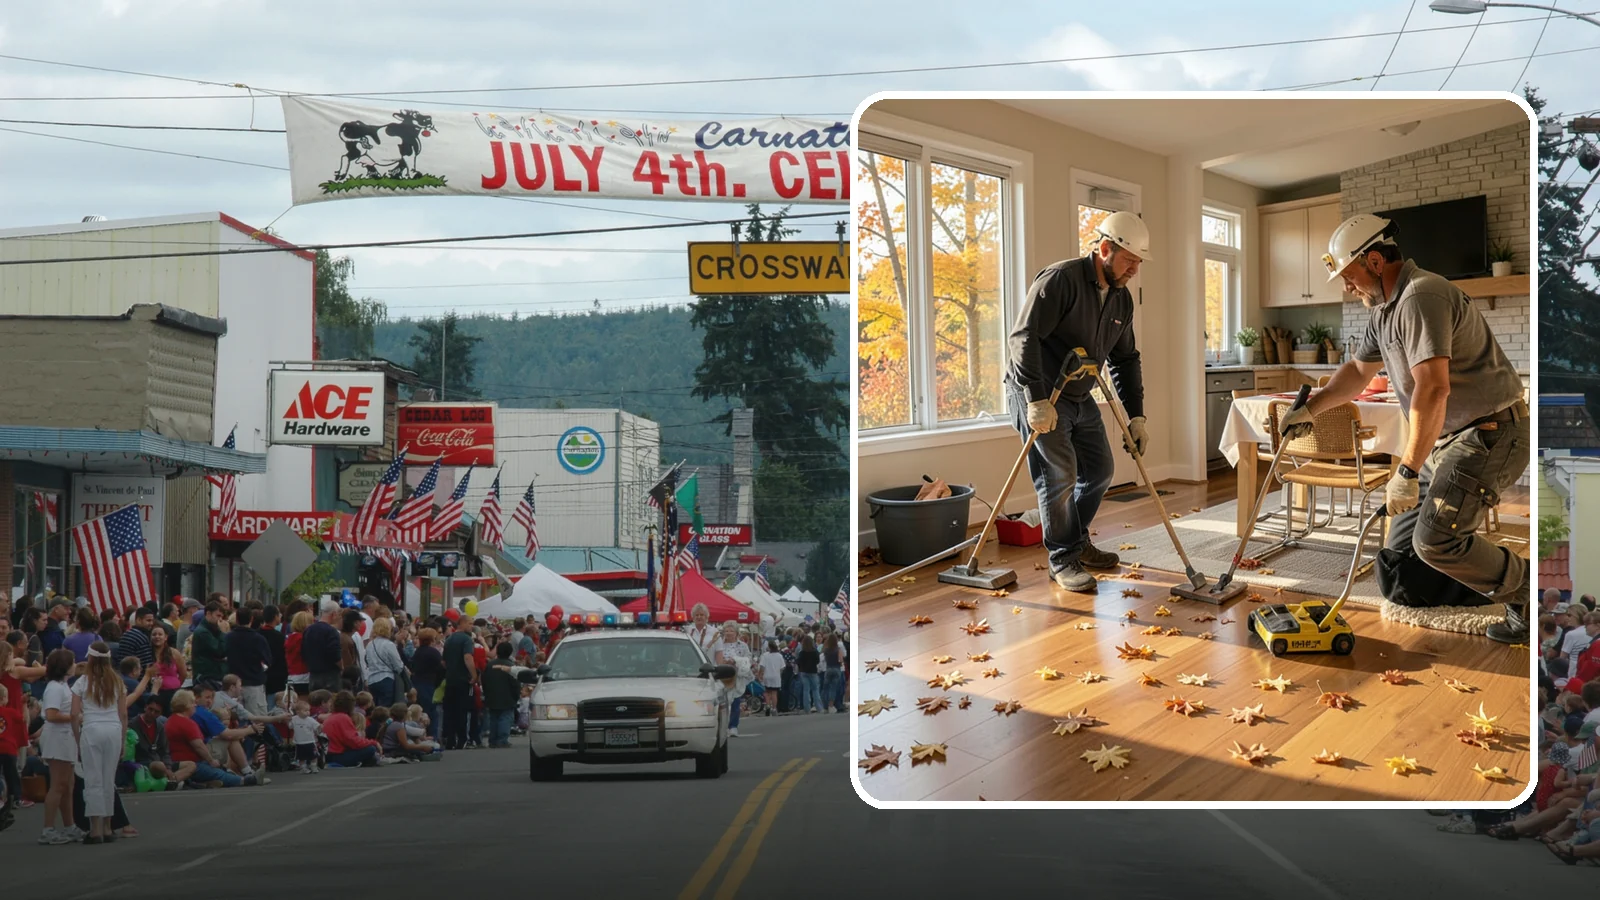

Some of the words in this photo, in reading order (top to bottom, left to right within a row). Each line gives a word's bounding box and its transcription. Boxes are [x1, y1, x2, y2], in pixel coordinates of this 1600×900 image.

[695, 121, 850, 149] Carnat
[481, 141, 604, 192] JULY
[632, 150, 746, 198] 4th.
[697, 254, 850, 280] CROSSWA
[283, 380, 373, 420] ACE
[405, 409, 453, 422] CEDAR
[461, 409, 485, 421] LOG
[283, 421, 371, 436] Hardware
[416, 428, 477, 446] Coca-Cola
[353, 467, 384, 480] Simpl
[95, 484, 124, 494] Vincent
[126, 486, 136, 494] de
[138, 486, 155, 495] Paul
[688, 526, 741, 535] CRNATION
[699, 535, 730, 543] GLASS
